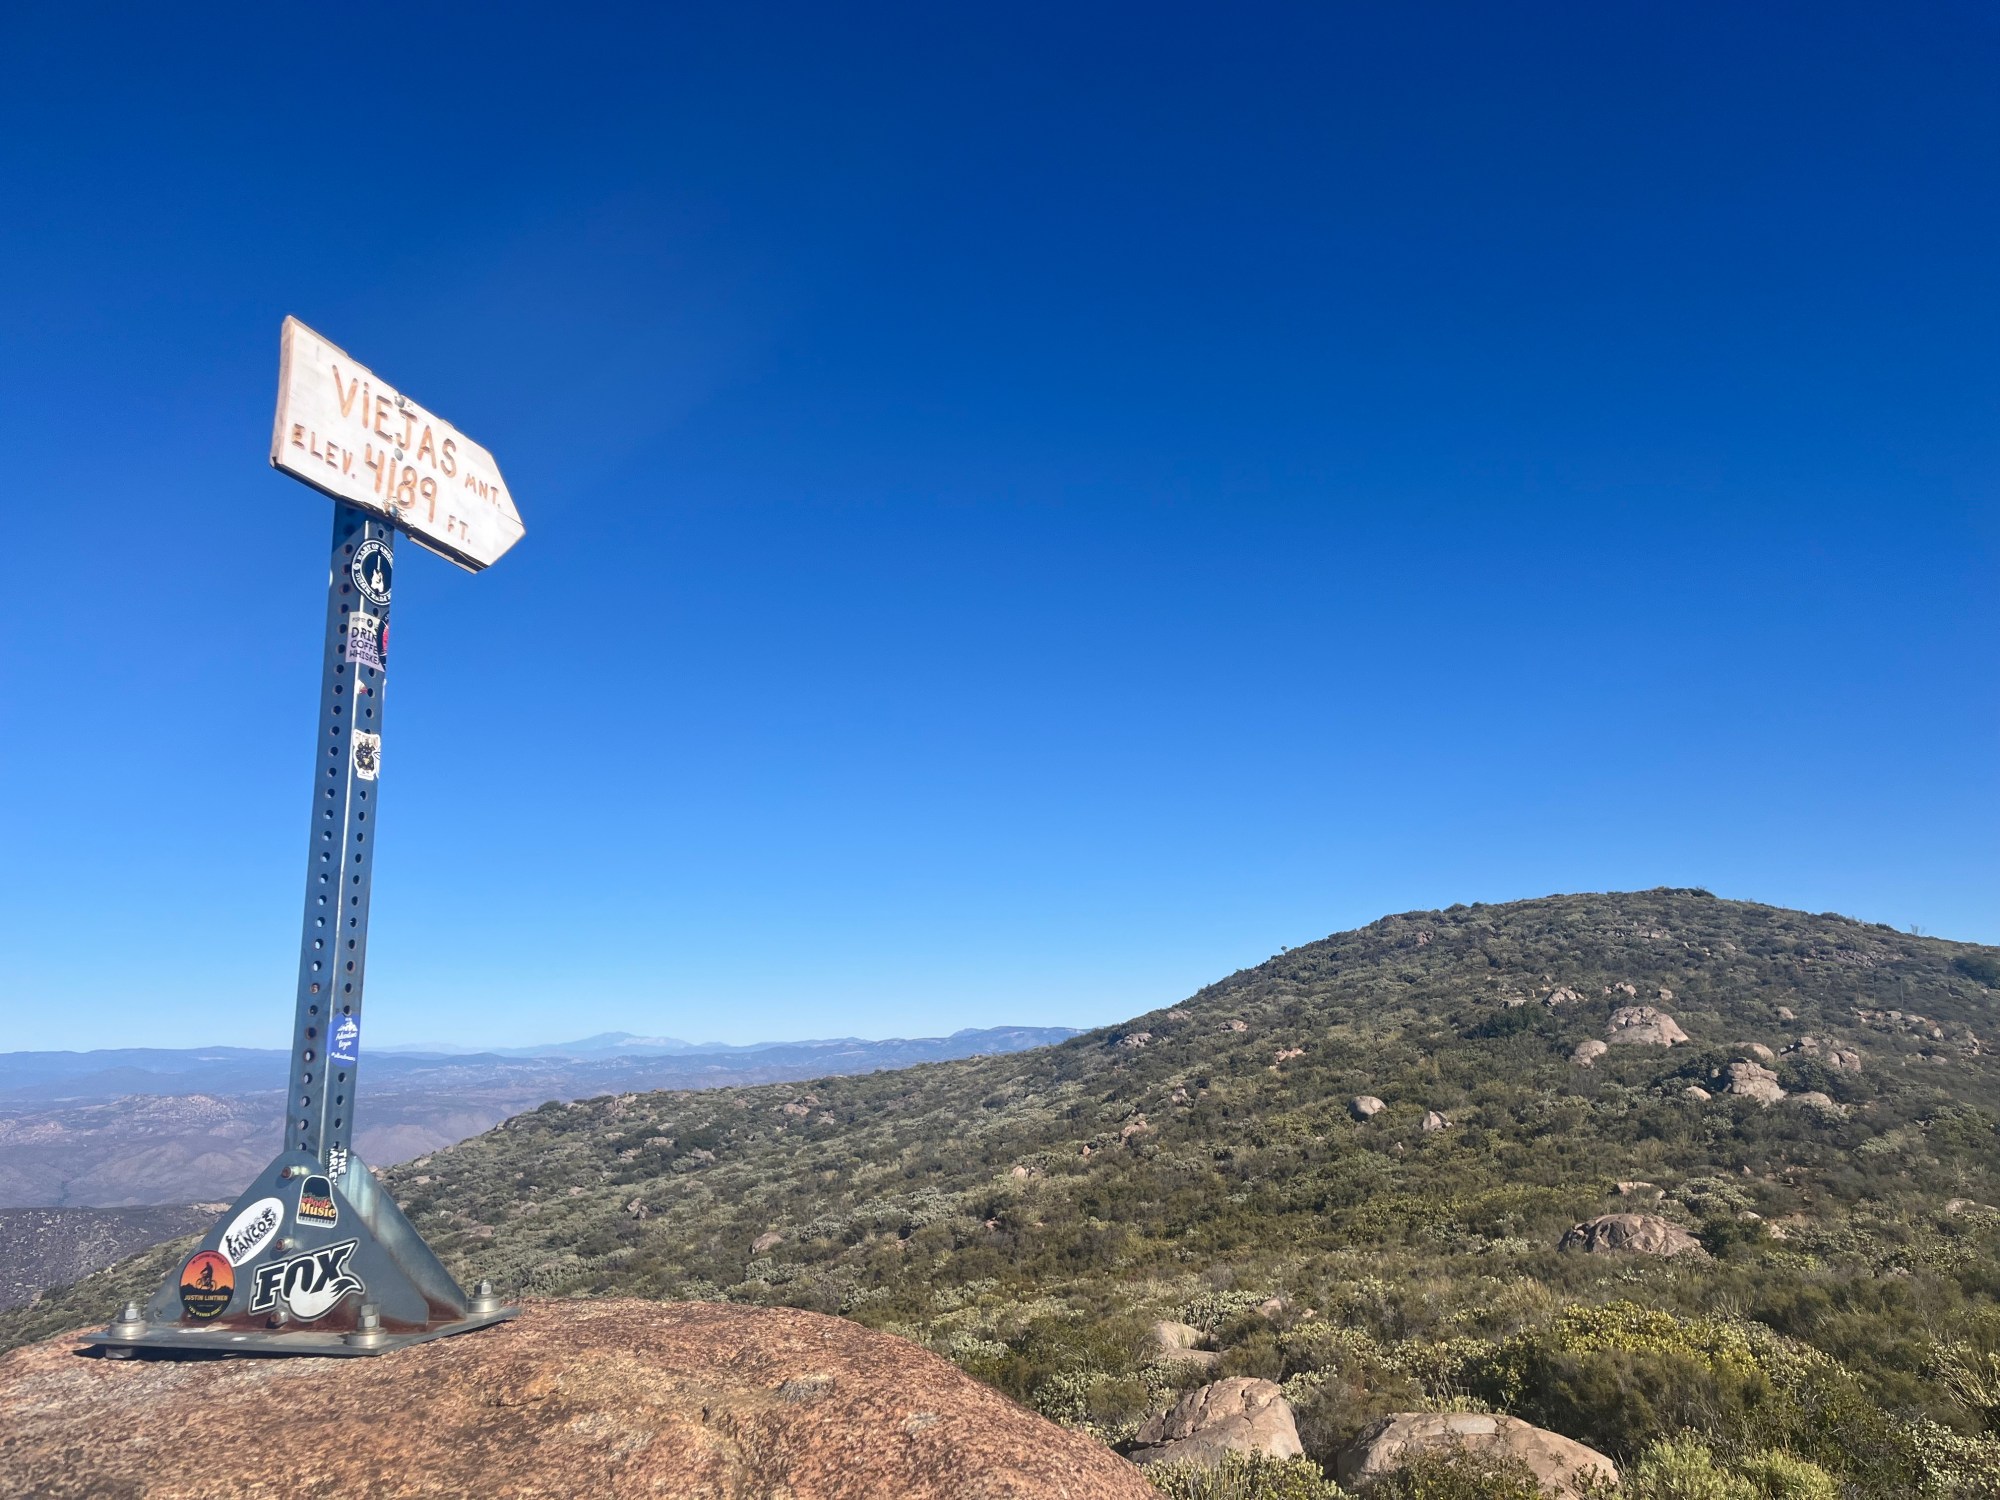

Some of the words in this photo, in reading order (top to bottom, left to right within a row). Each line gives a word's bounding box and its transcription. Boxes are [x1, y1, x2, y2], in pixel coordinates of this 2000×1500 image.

[291, 423, 356, 480] ELEV.
[364, 443, 438, 524] 4189
[447, 514, 471, 545] FT.
[464, 473, 501, 509] MNT.
[350, 640, 378, 655] COFFE
[351, 627, 377, 643] DRIN
[328, 1148, 339, 1186] ARLEY
[337, 1148, 347, 1175] THE
[299, 1202, 337, 1217] Music
[230, 1216, 274, 1261] MANCOS
[252, 1242, 355, 1311] FOX
